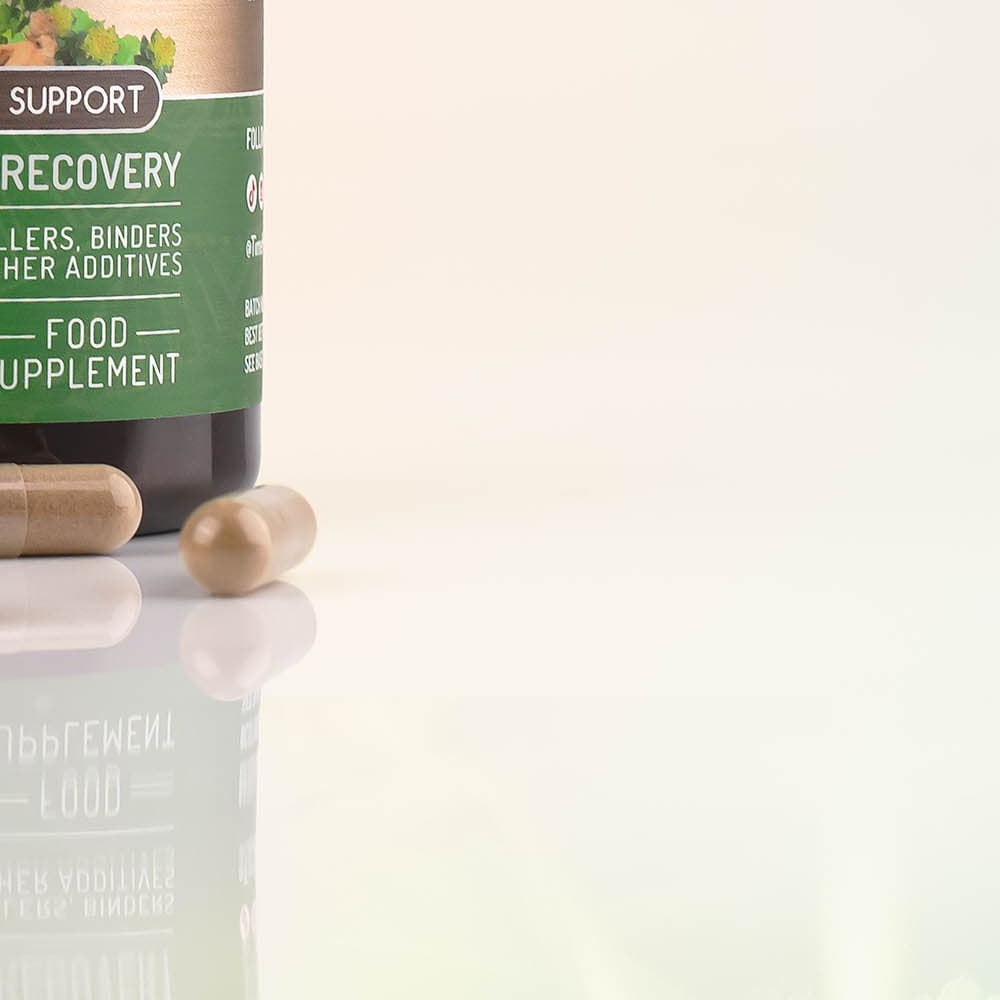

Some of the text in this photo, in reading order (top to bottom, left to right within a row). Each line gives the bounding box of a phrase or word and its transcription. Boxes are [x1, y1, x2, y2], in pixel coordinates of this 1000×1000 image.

[9, 85, 144, 115] SUPPORT
[1, 152, 181, 191] RECOVERY
[91, 223, 181, 249] BINDERS
[65, 252, 182, 279] ADDITIVES
[47, 317, 127, 349] FOOD
